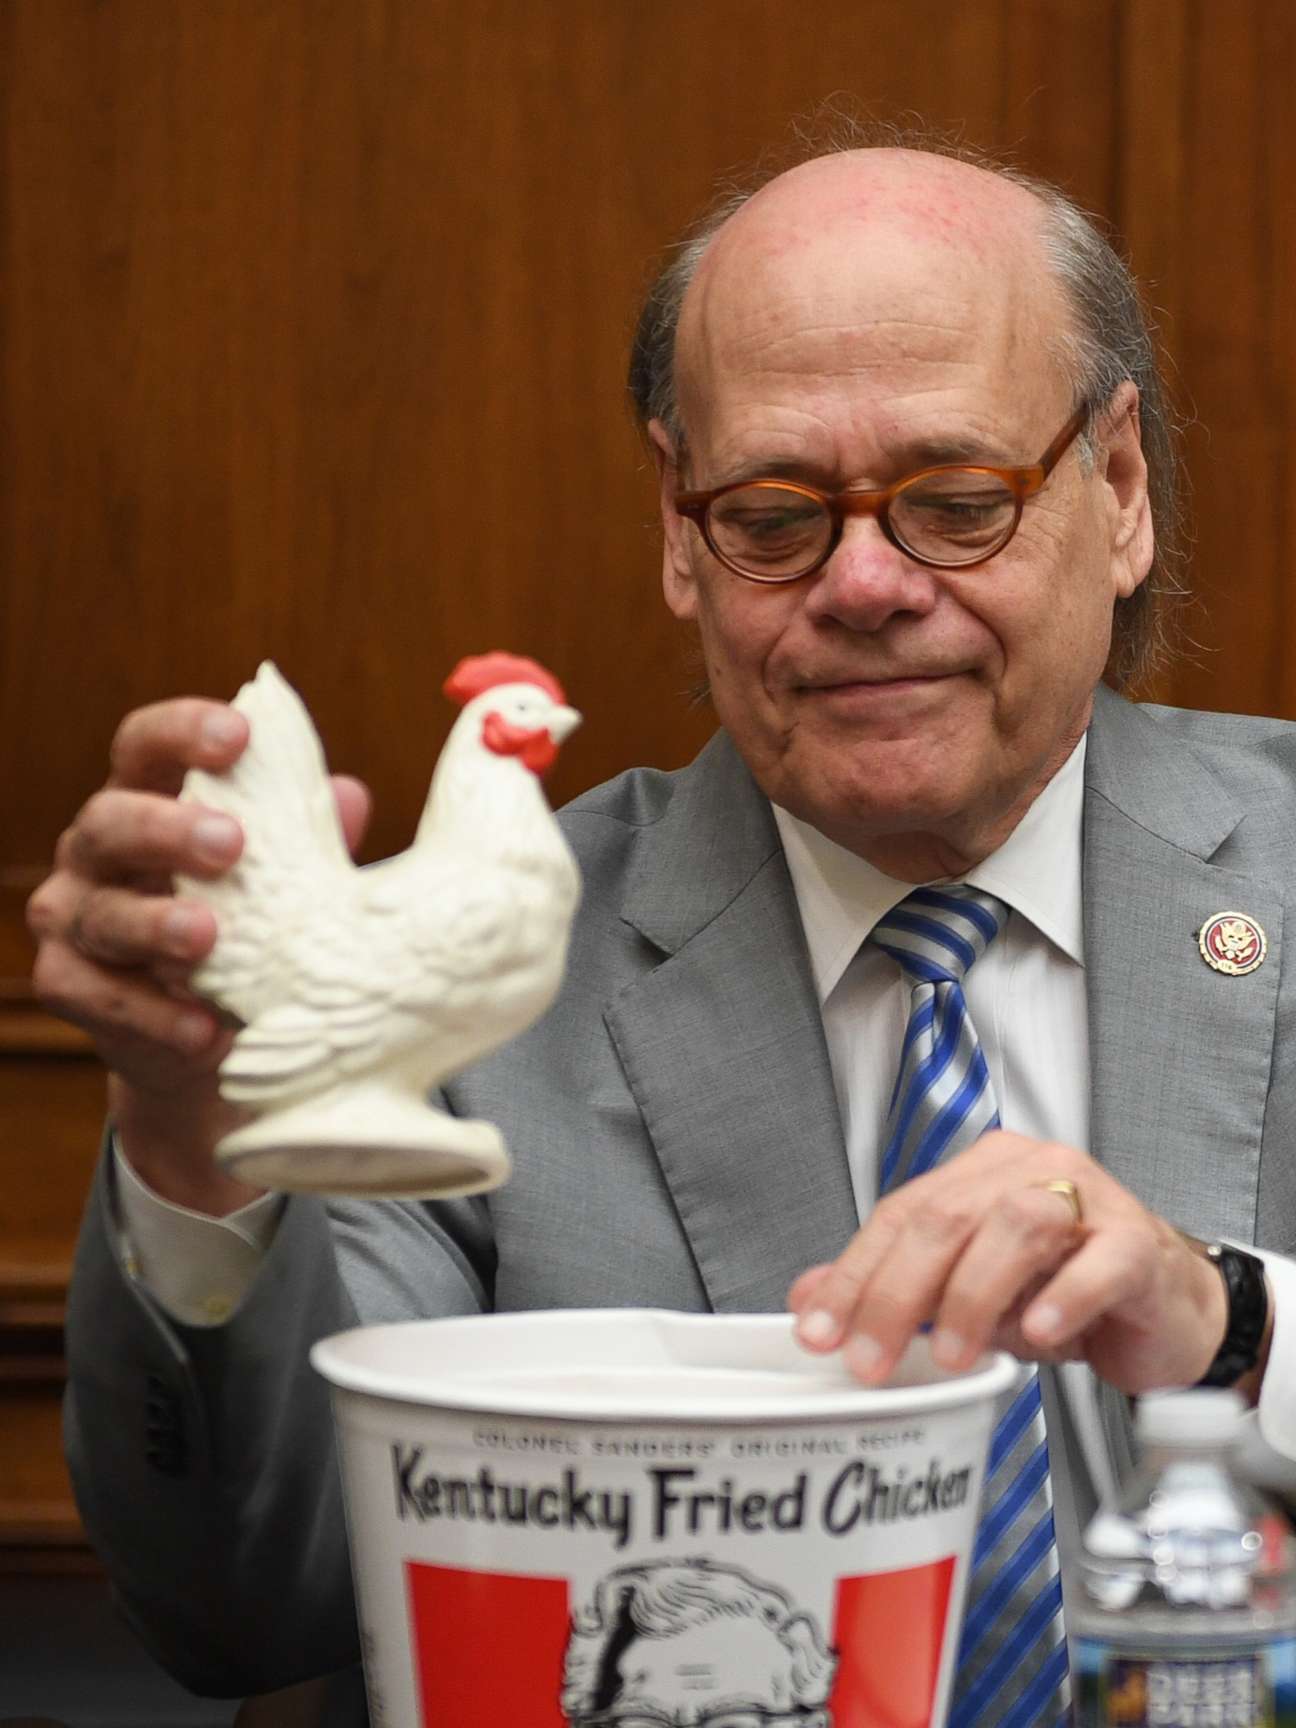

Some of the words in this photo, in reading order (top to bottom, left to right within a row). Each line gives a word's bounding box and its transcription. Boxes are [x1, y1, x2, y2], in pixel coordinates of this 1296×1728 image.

[474, 1431, 580, 1454] COLONEL
[733, 1437, 847, 1456] ORIGINAL
[857, 1428, 925, 1450] RECIPE
[390, 1439, 631, 1549] Kentucky
[646, 1466, 808, 1541] Fried
[823, 1458, 973, 1536] Chicken
